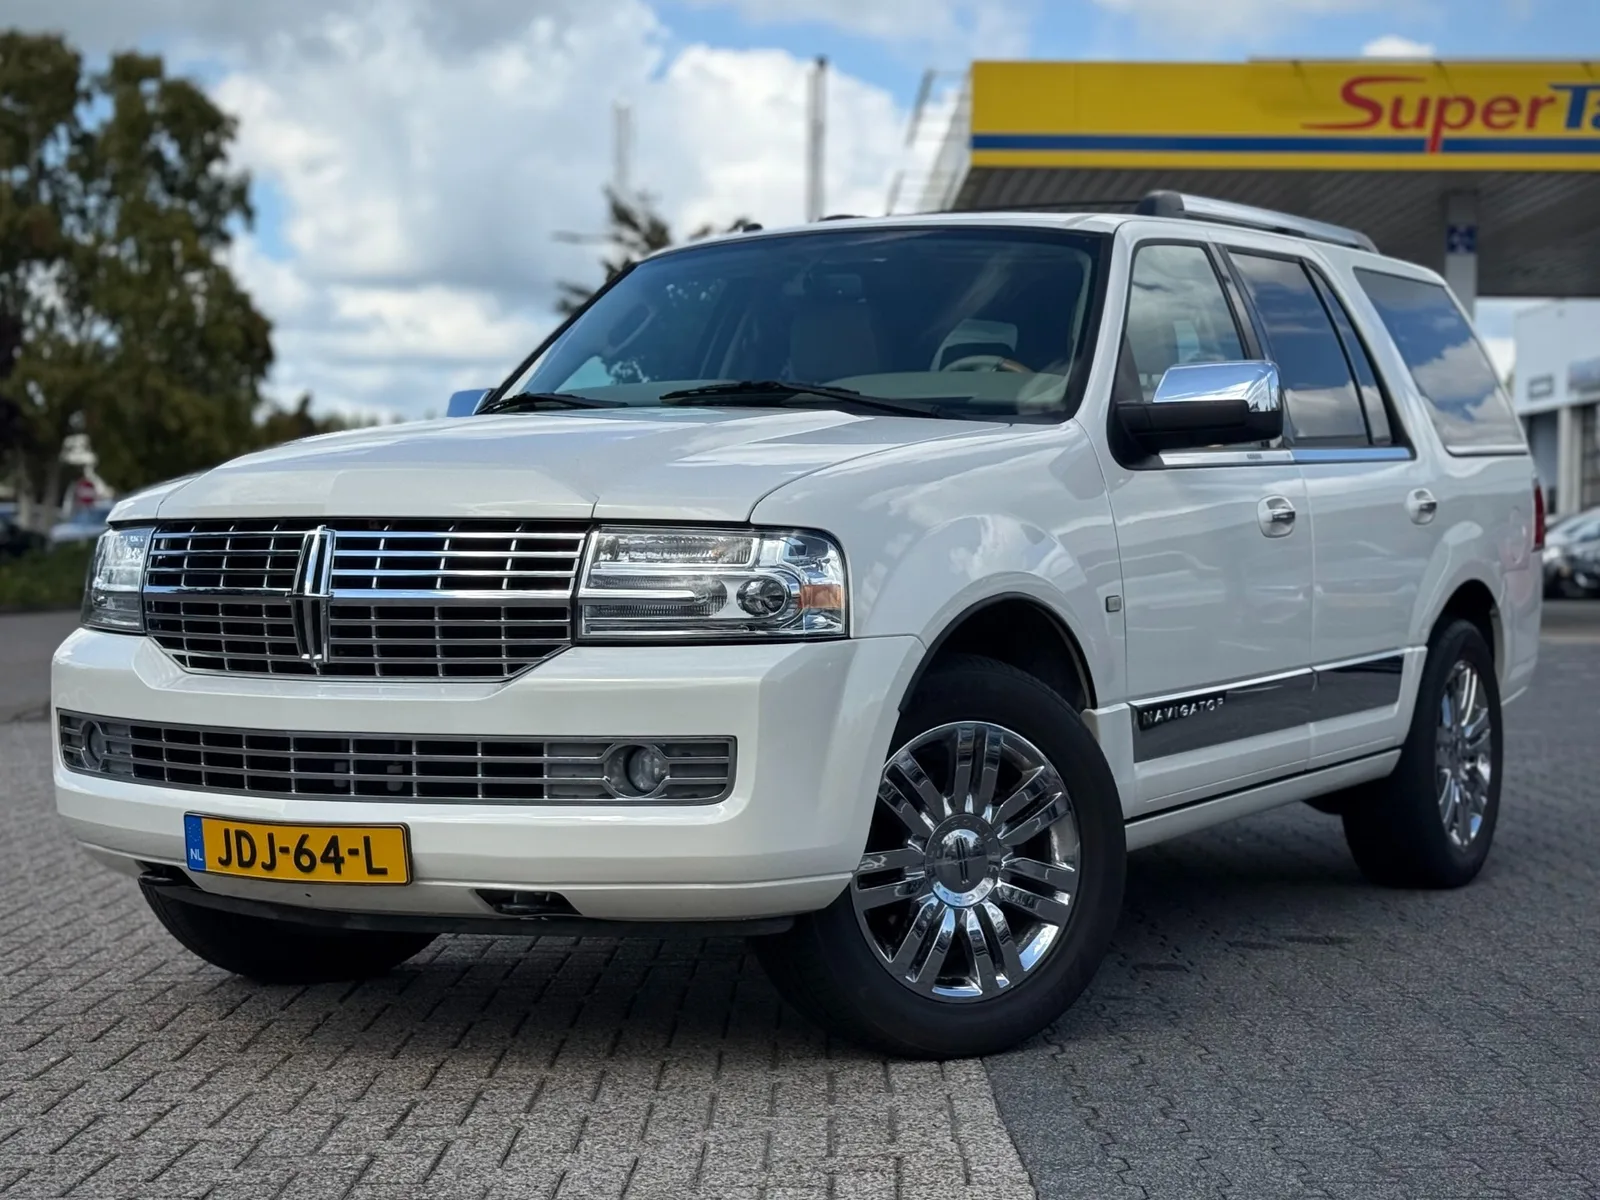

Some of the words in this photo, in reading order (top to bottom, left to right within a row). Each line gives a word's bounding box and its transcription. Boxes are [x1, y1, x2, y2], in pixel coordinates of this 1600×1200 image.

[1299, 75, 1600, 154] SuperT
[1142, 697, 1224, 724] NAVIGATOR
[190, 848, 204, 861] NL
[217, 828, 388, 876] JDJ-64-L
